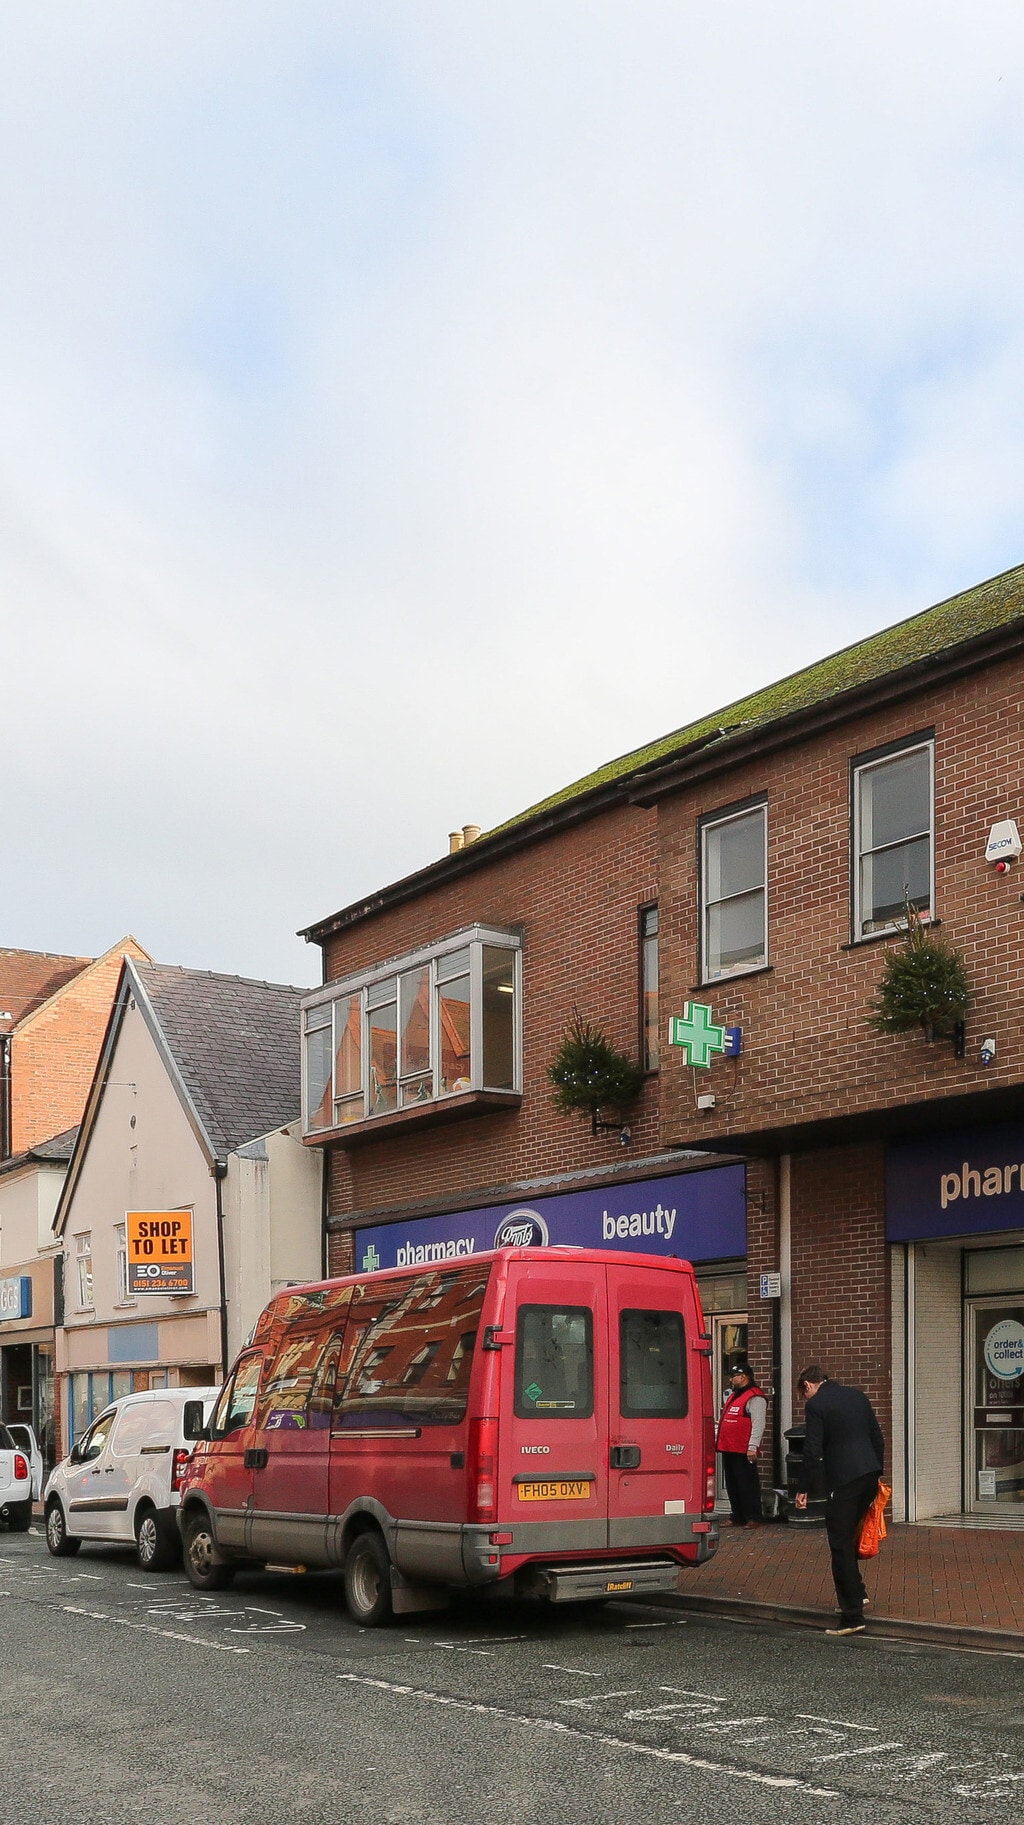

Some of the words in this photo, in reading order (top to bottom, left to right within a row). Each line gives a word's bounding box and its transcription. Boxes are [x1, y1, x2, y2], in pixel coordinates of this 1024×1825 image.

[988, 838, 1013, 852] SECOM
[602, 1203, 677, 1240] beauty
[138, 1221, 181, 1238] SHOP
[500, 1222, 533, 1248] Boots
[132, 1239, 154, 1255] TO
[161, 1238, 188, 1254] LET
[396, 1235, 475, 1267] pharmacy
[151, 1279, 166, 1287] 236
[993, 1349, 1024, 1360] collect
[521, 1446, 550, 1454] IVECO
[665, 1443, 685, 1452] Daily
[523, 1483, 557, 1497] FH05
[560, 1482, 584, 1495] OXV
